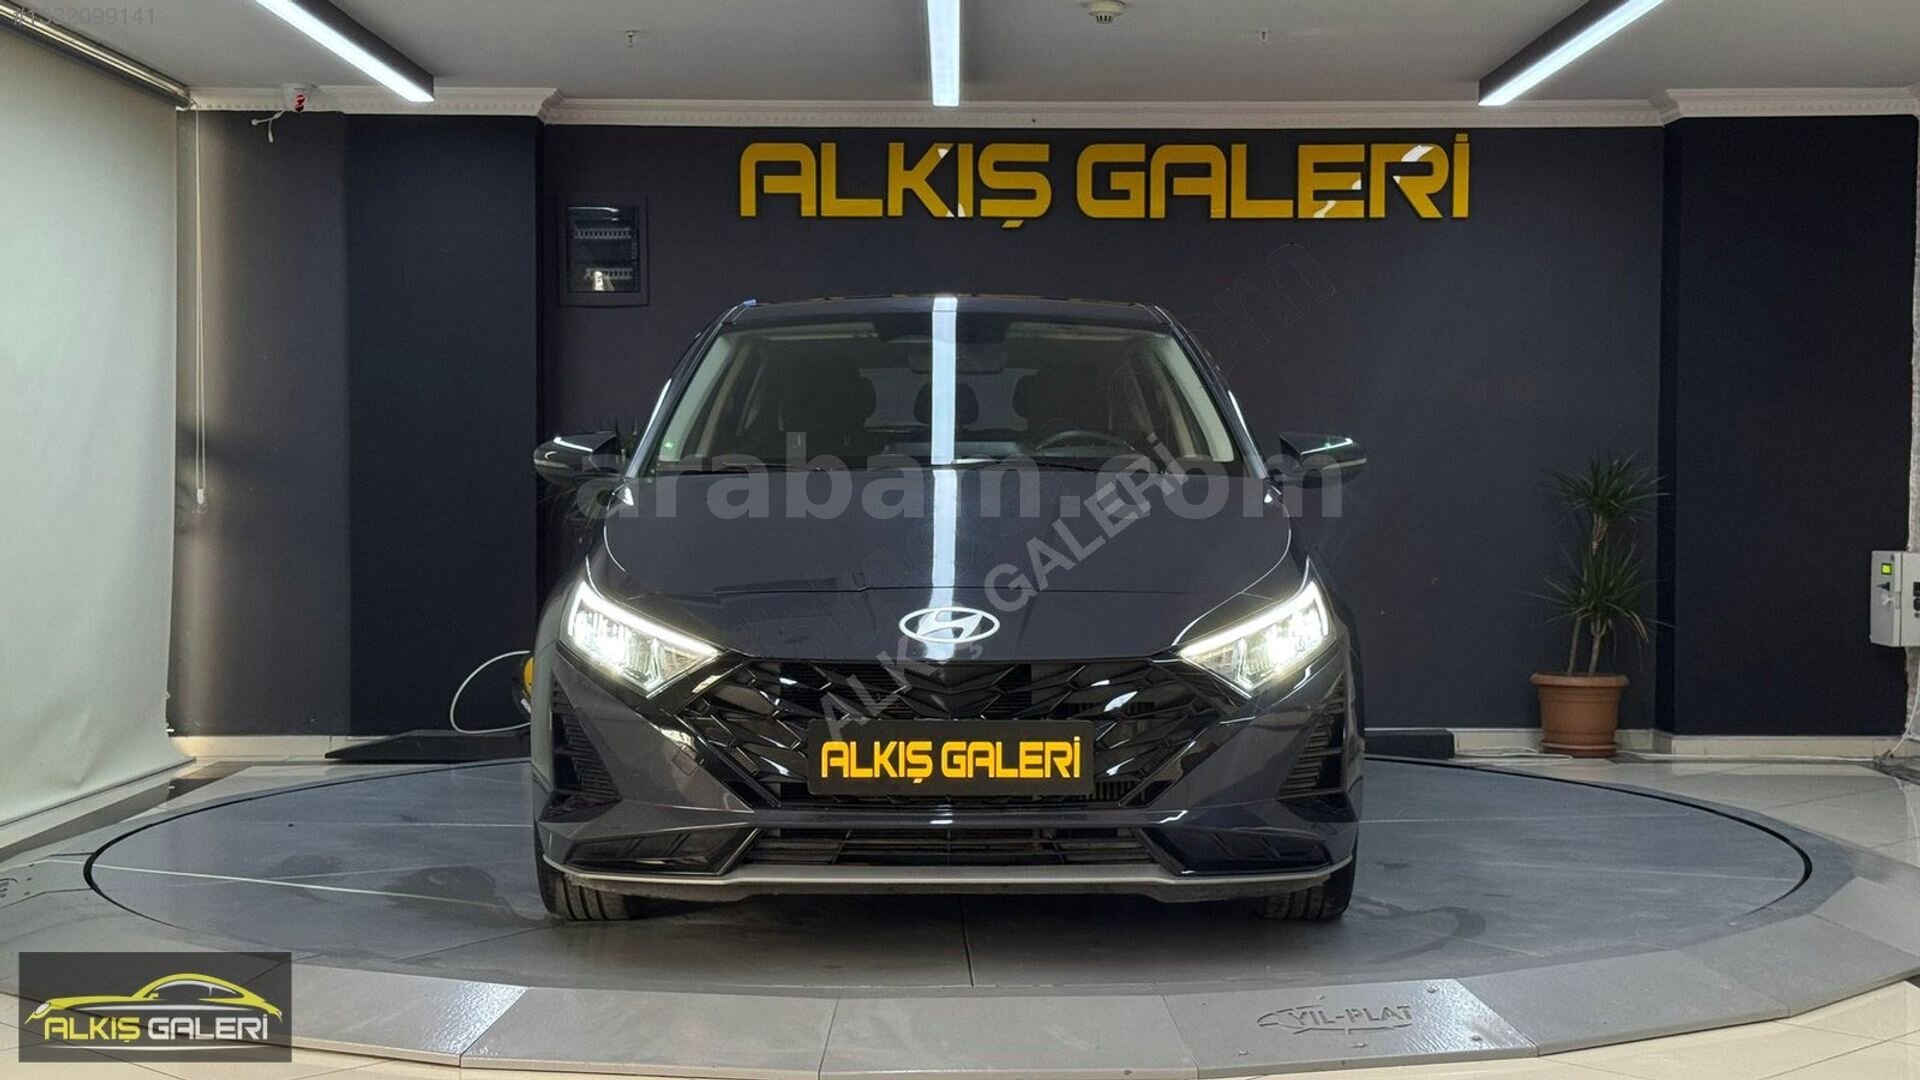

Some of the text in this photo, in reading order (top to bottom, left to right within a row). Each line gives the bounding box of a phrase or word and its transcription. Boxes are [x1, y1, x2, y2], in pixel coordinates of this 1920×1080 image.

[740, 133, 1469, 228] ALKIŞ GALERİ
[821, 736, 1080, 783] ALKIŞ GALERİ
